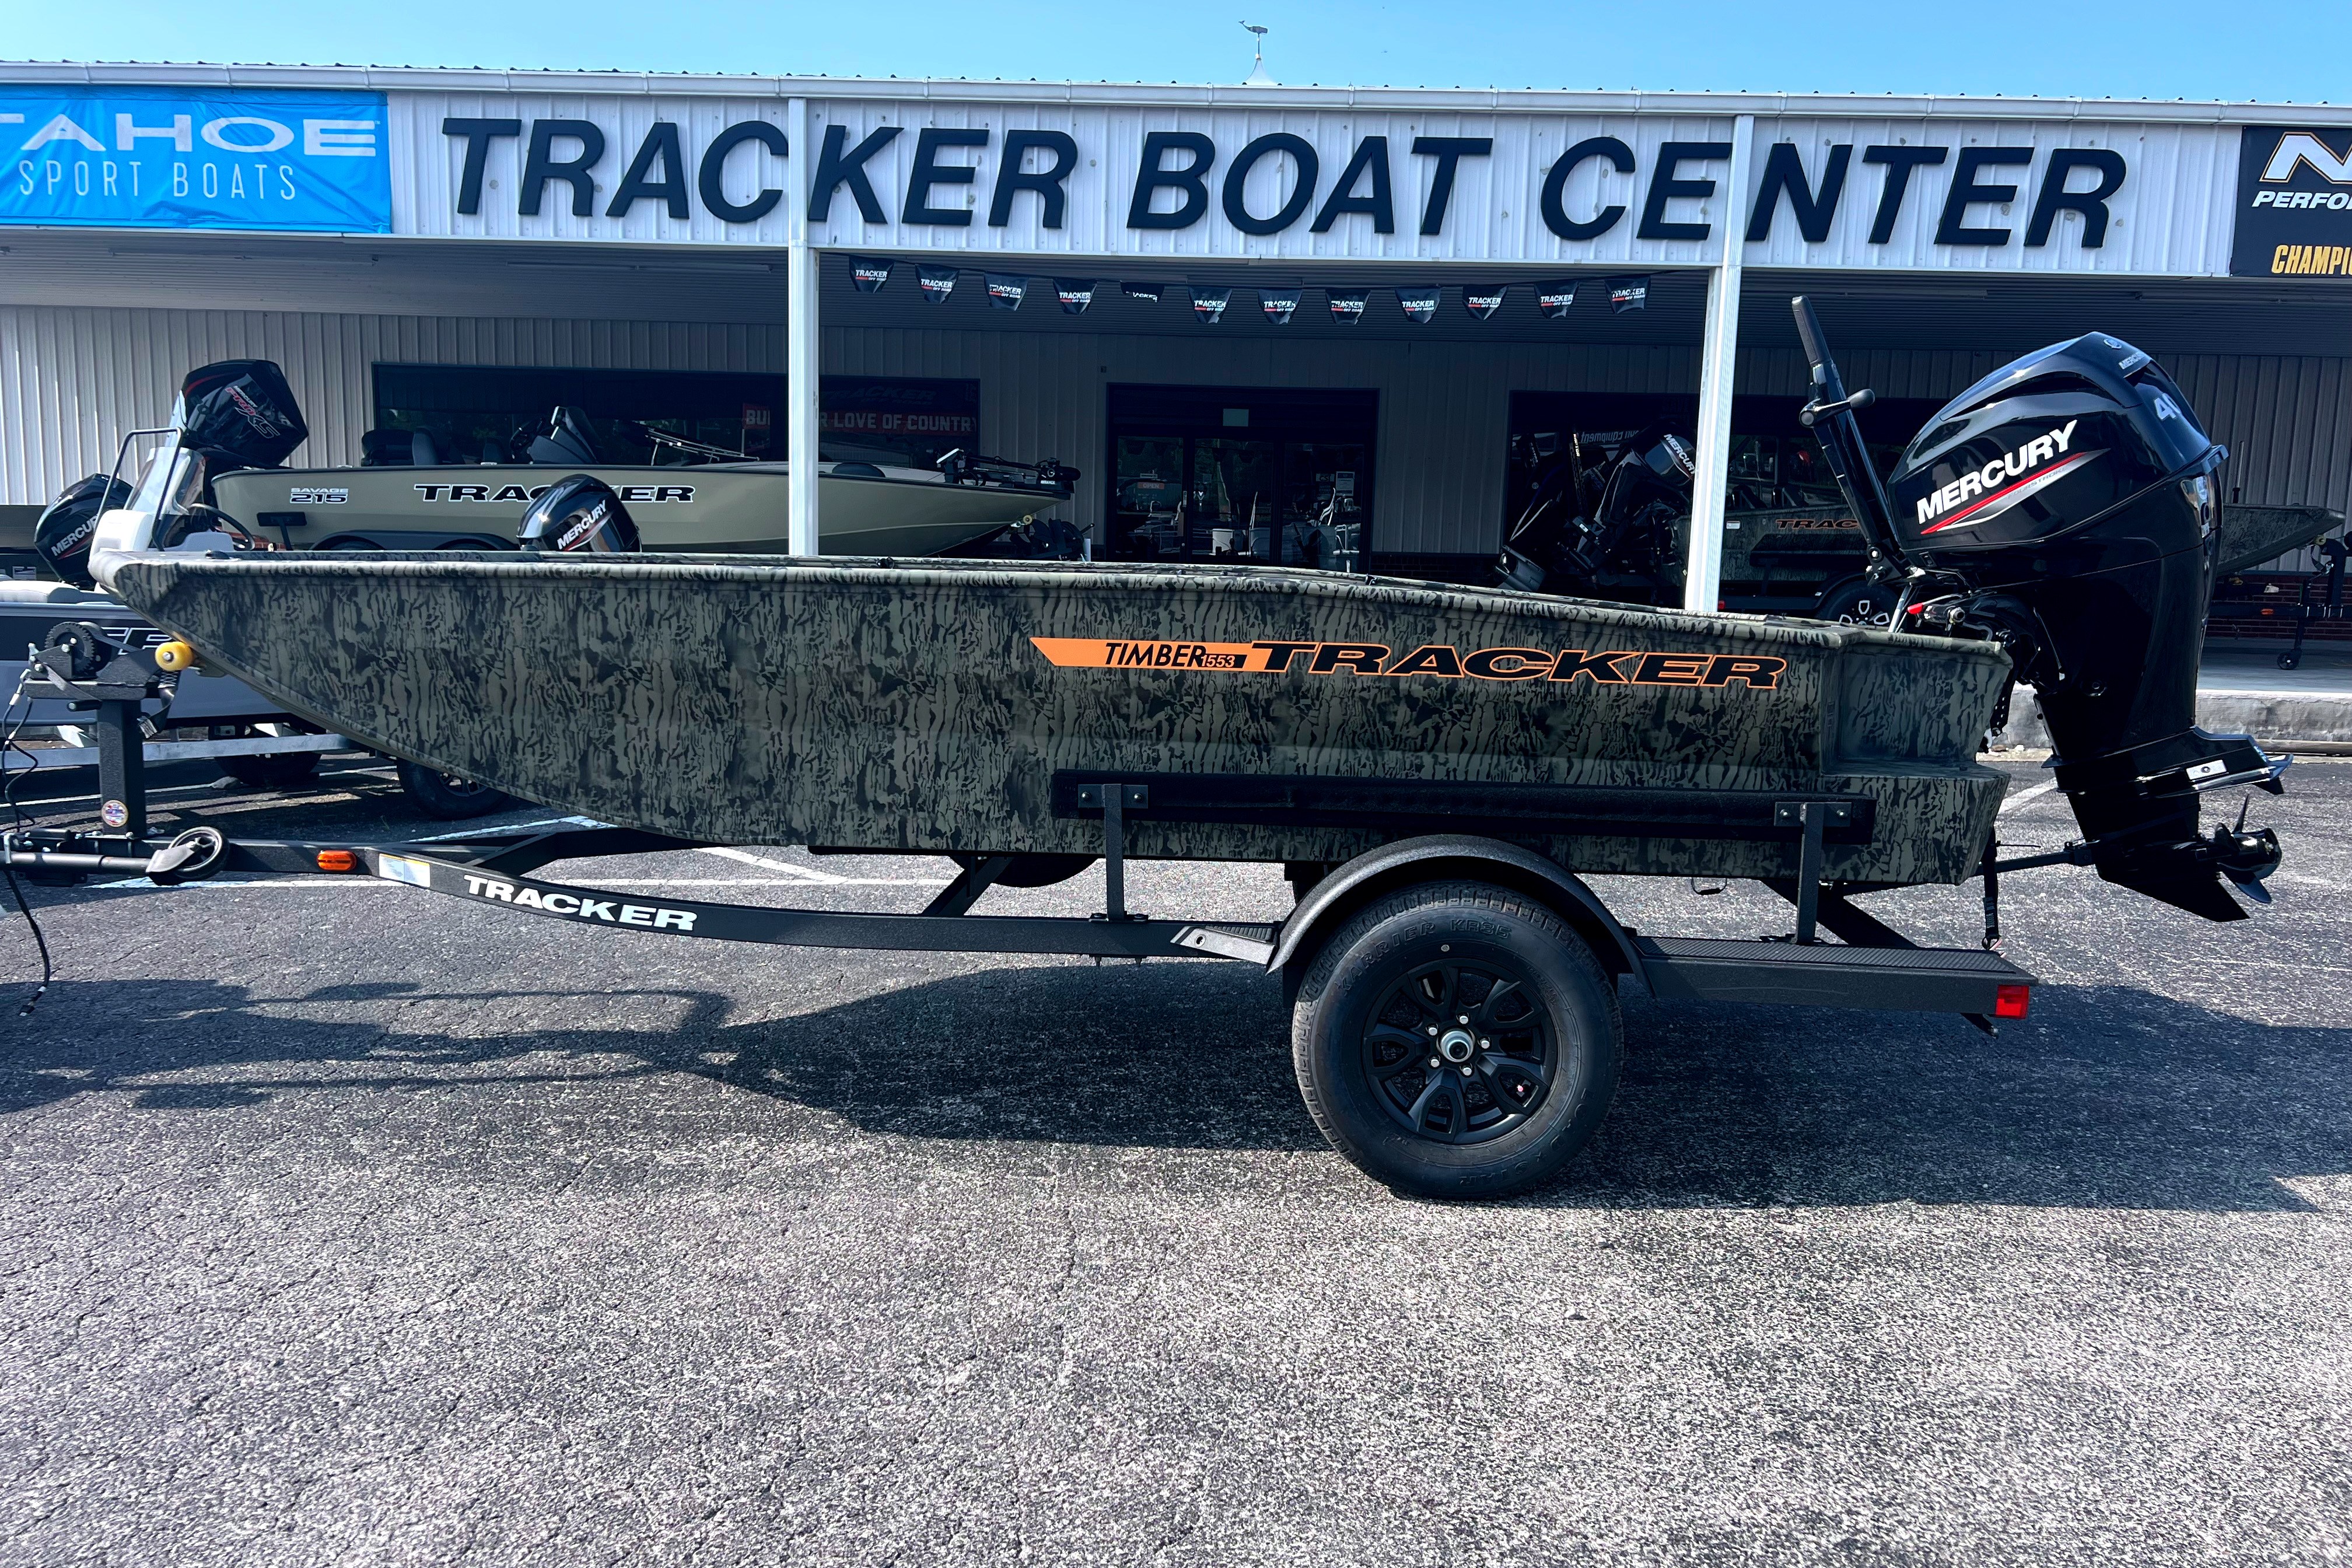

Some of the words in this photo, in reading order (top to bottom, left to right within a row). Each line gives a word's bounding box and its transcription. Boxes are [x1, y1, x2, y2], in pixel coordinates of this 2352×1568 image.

[0, 113, 376, 156] AHOE
[19, 159, 142, 197] SPORT
[173, 162, 296, 201] BOATS
[442, 117, 1078, 229] TRACKER
[1126, 131, 1493, 236] BOAT
[1540, 136, 2127, 248] CENTER
[2252, 191, 2352, 210] PERFO
[855, 270, 887, 278] TRACKER
[2271, 244, 2352, 275] CHAMPI
[921, 278, 953, 288] TRACKER
[1541, 294, 1573, 303] TRACKER
[1402, 300, 1434, 308] TRACKER
[1468, 297, 1501, 305] TRACKER
[834, 412, 877, 429] LOVE
[882, 414, 904, 430] OF
[1917, 419, 2078, 524] MERCURY
[2008, 466, 2069, 499] FOURSTROKE
[290, 493, 348, 504] 215
[414, 484, 695, 503] TRAER
[51, 514, 98, 556] MERCUR
[556, 500, 608, 550] MERCURY
[1776, 519, 1860, 530] TRAC
[1105, 642, 1203, 668] TIMBER
[1200, 654, 1236, 668] 1553
[1251, 640, 1788, 690] TRACKER
[463, 874, 697, 932] TRACKER
[1335, 921, 1436, 997] KARRIER
[1450, 918, 1513, 940] KR35
